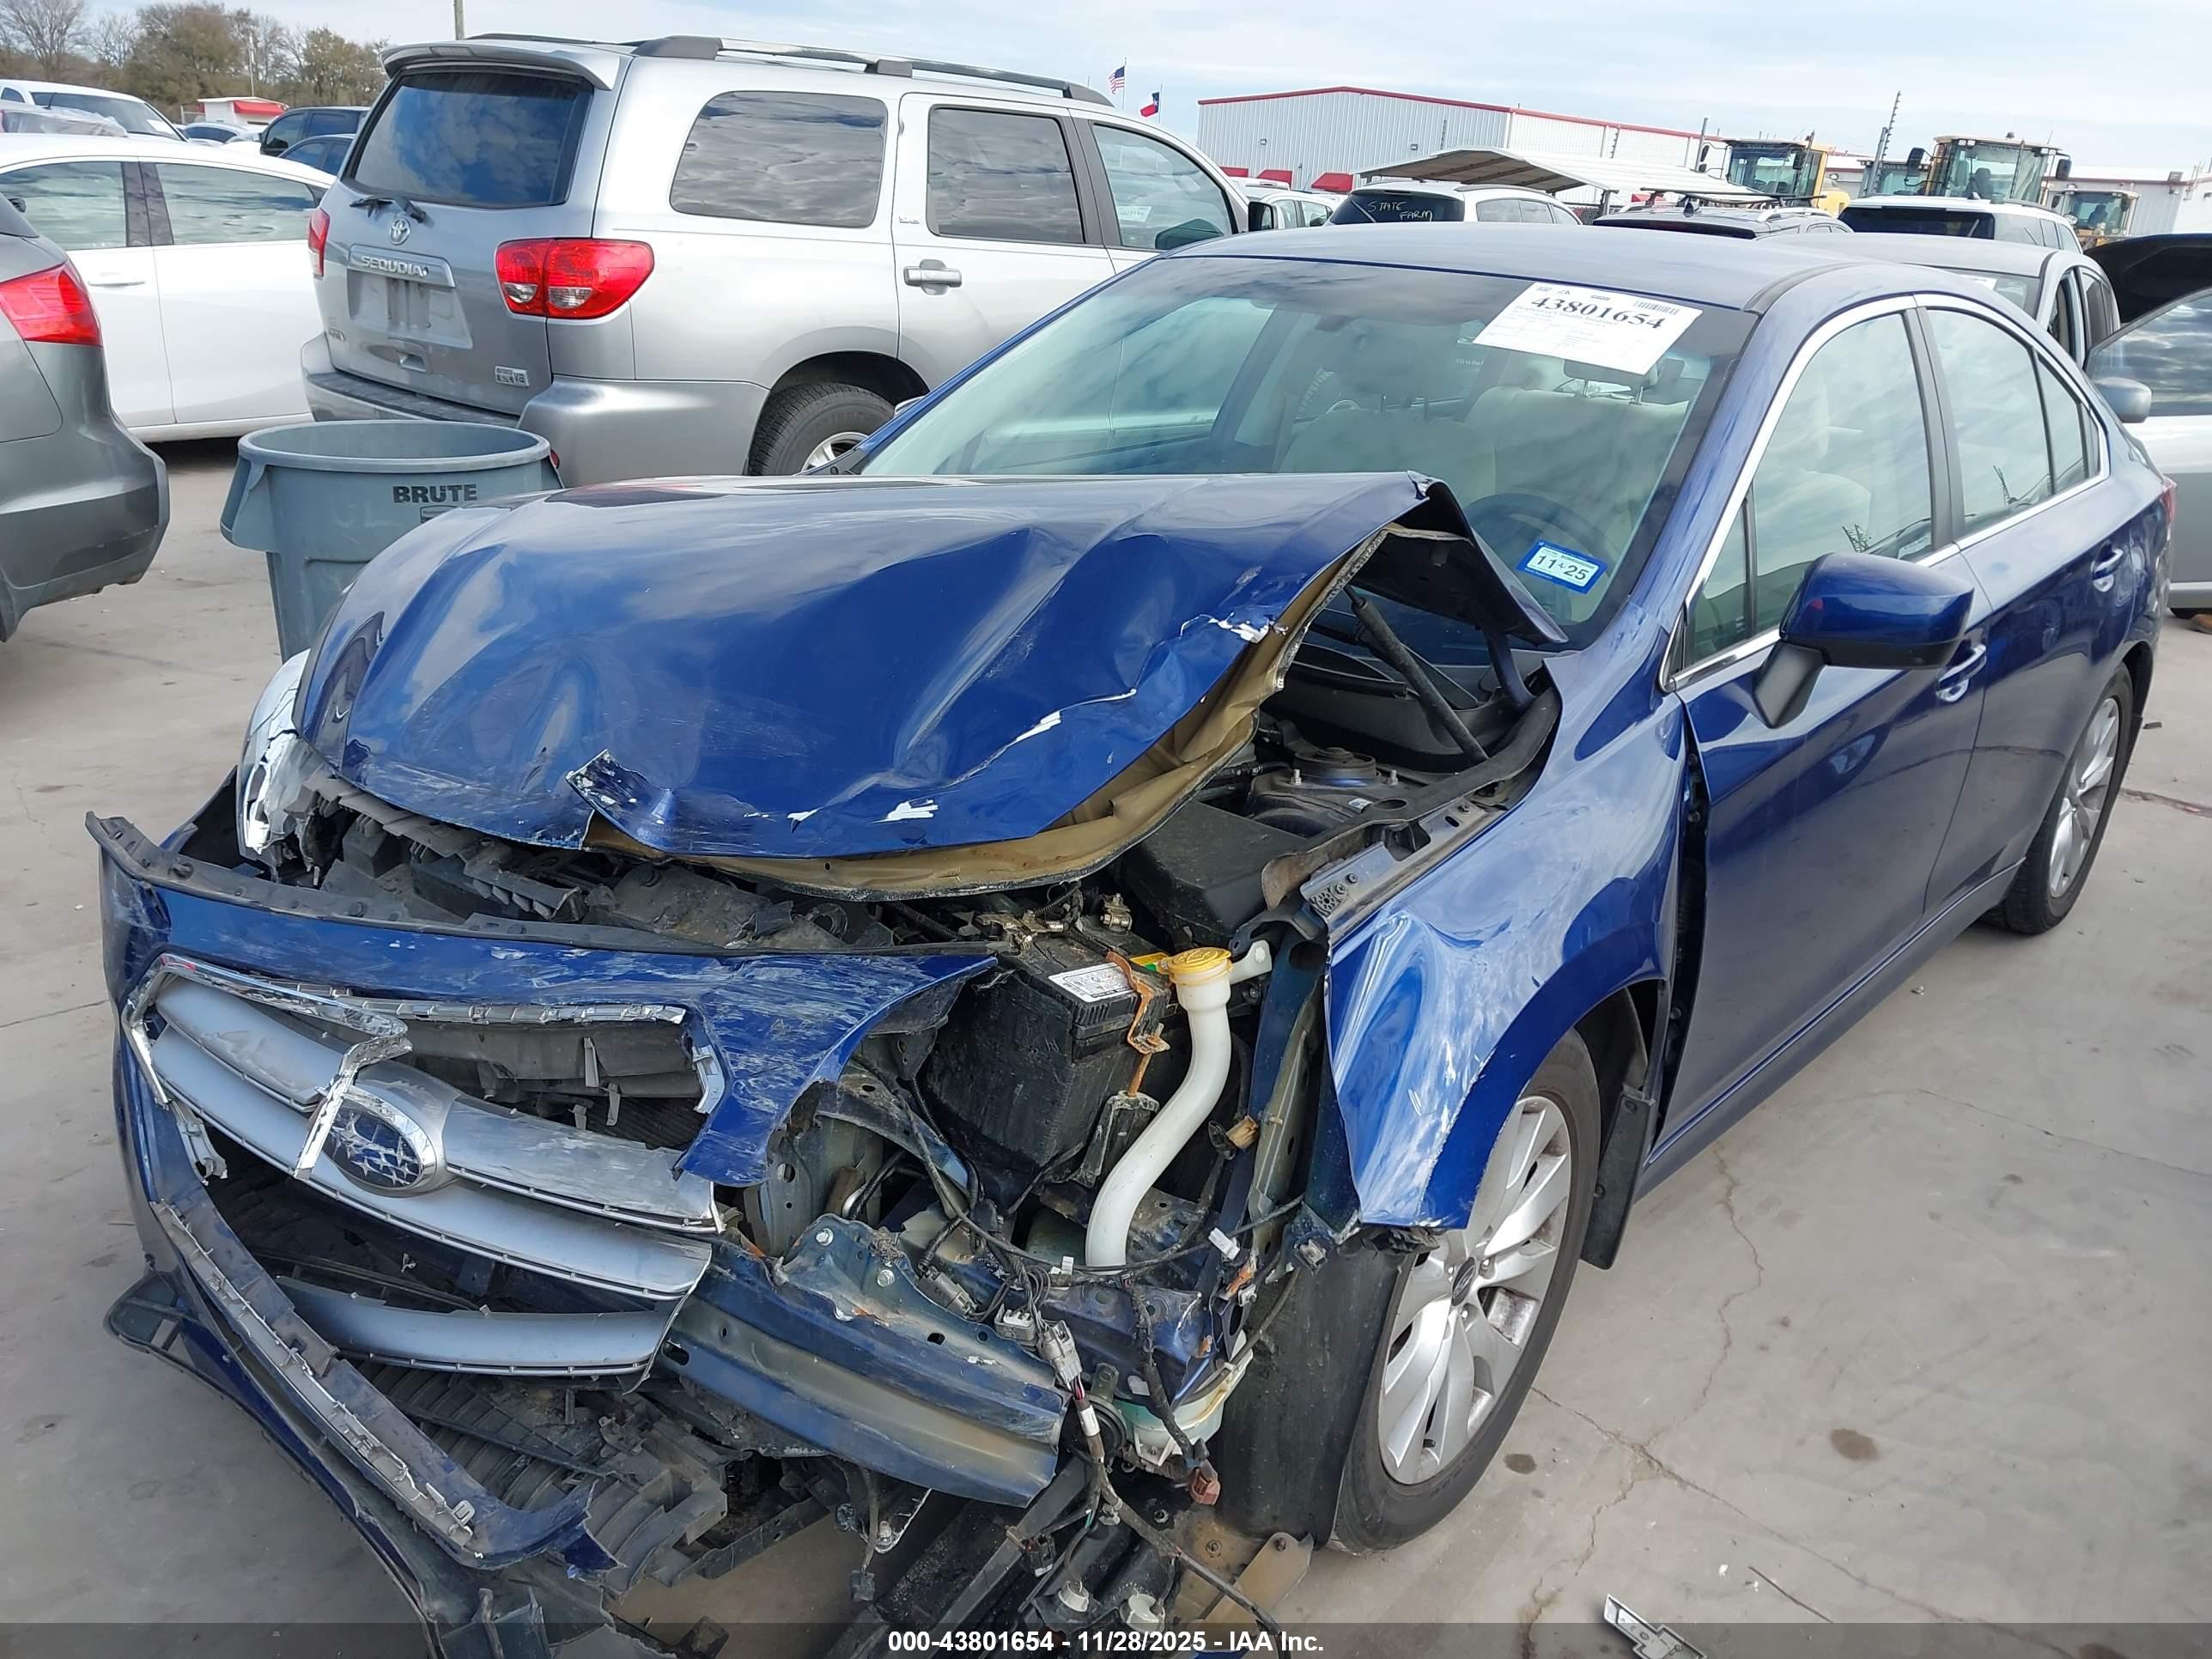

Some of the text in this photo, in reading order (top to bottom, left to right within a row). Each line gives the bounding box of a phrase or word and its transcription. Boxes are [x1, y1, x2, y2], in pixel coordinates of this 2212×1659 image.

[1367, 200, 1408, 213] STATE
[1399, 210, 1433, 222] FARM
[362, 255, 423, 277] SEQUOIA
[1531, 296, 1666, 329] 43801654
[392, 483, 477, 503] BRUTE
[1537, 555, 1558, 569] 11
[1564, 565, 1589, 580] 25
